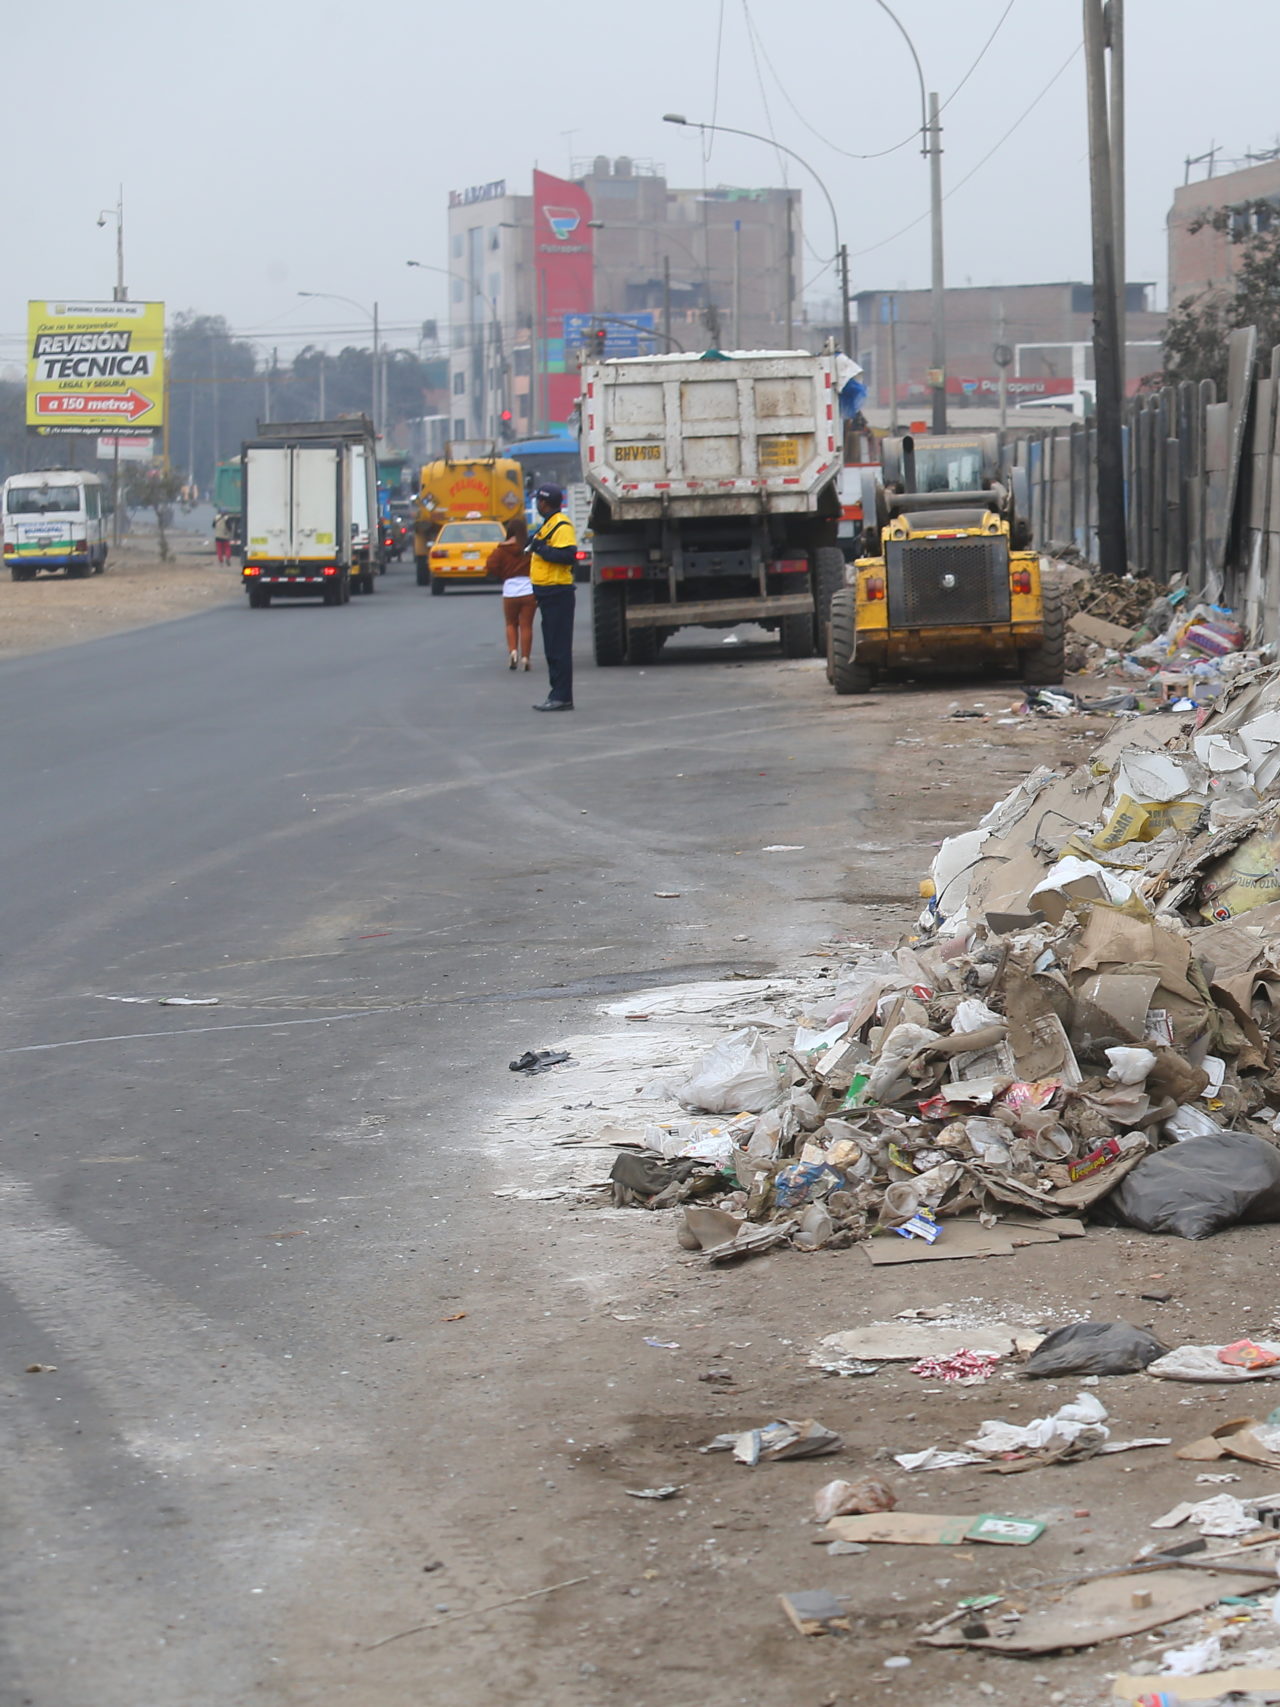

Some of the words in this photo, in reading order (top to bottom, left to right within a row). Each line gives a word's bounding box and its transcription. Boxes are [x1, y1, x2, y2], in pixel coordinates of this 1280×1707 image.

[38, 331, 129, 354] REVISIÓN
[44, 354, 149, 378] TÉCNICA
[58, 381, 82, 389] LEGAL
[48, 400, 58, 410] a
[62, 398, 85, 410] 150
[88, 398, 135, 410] metros
